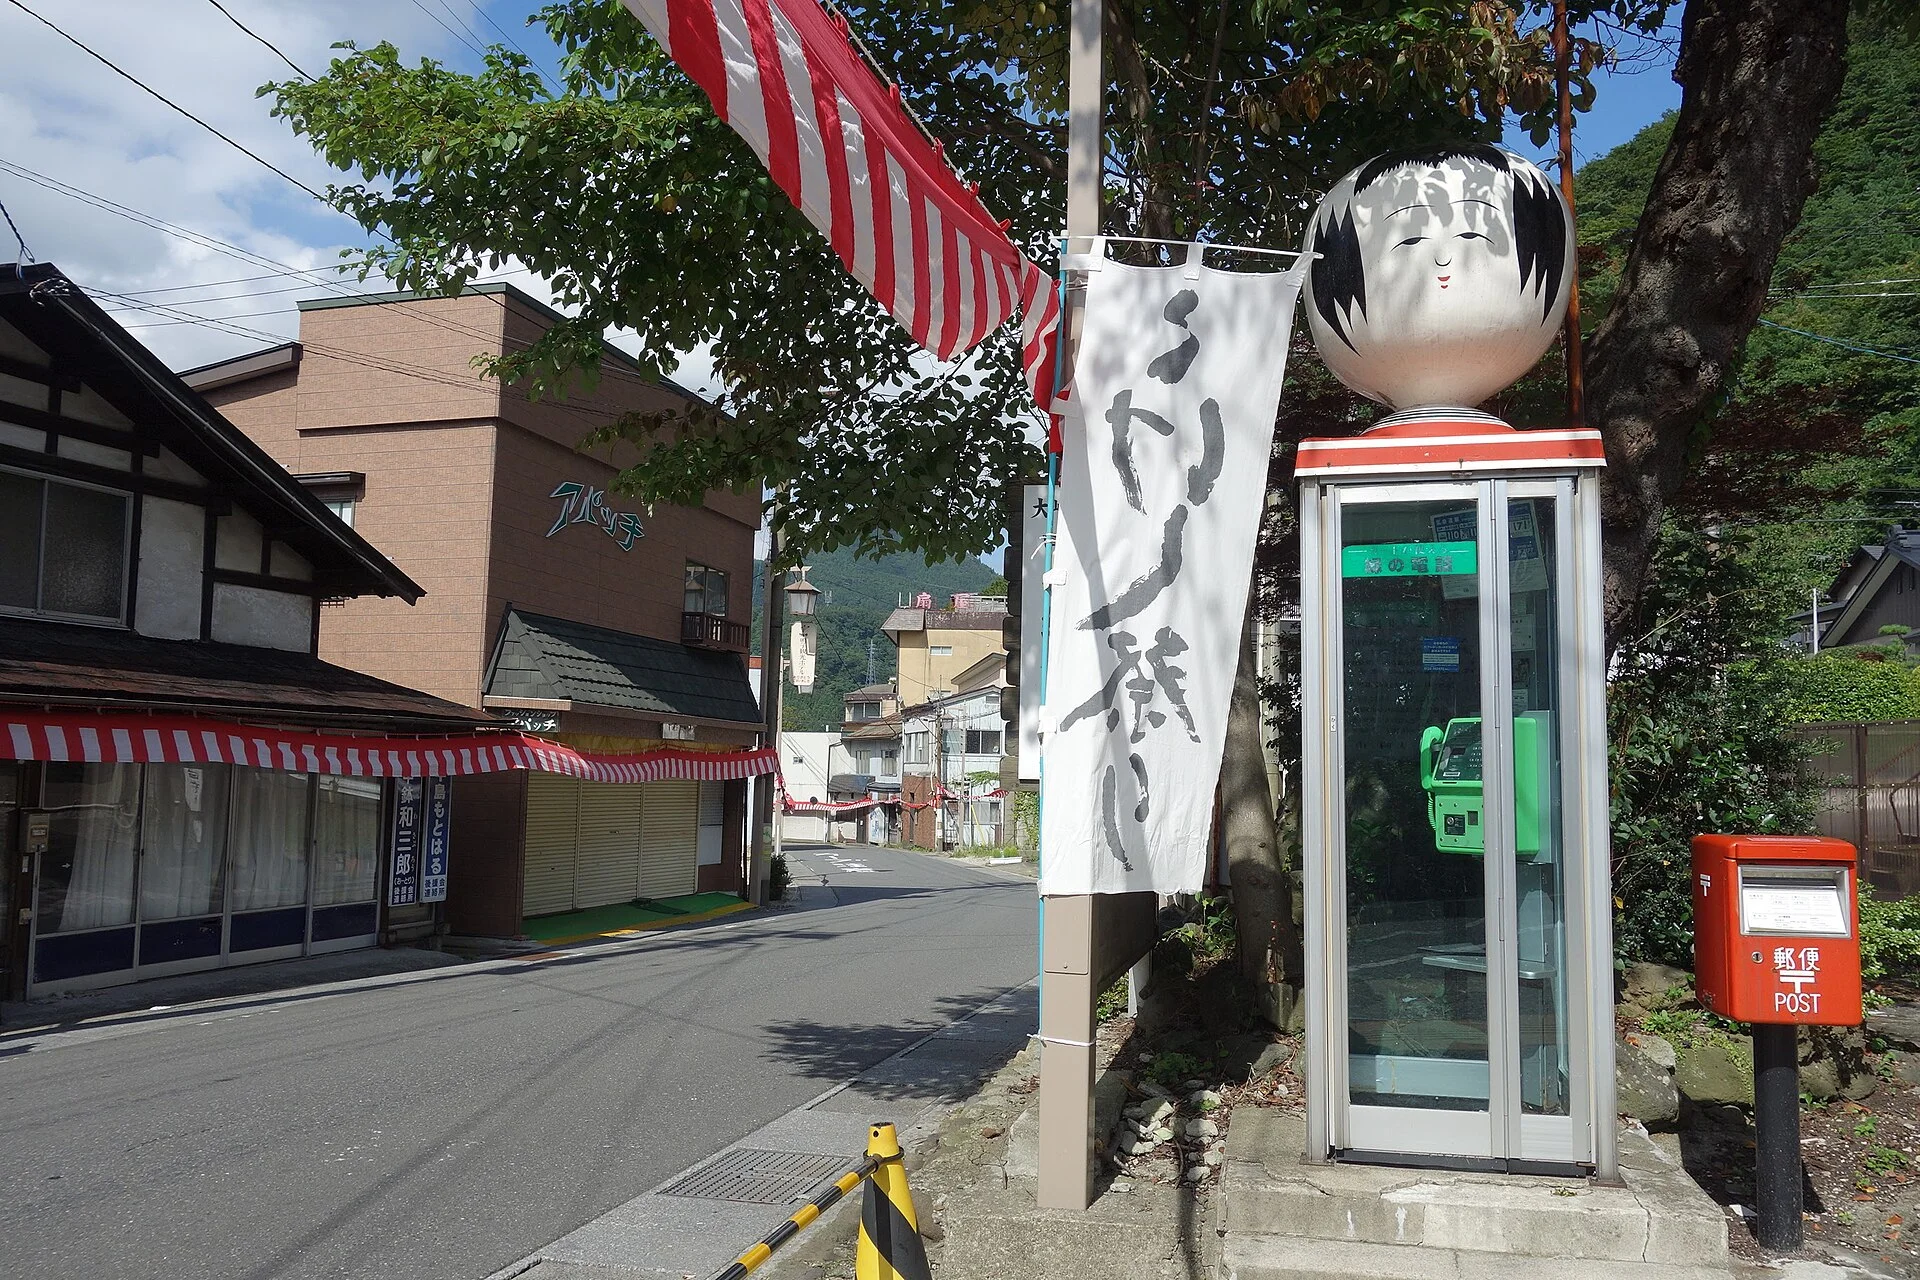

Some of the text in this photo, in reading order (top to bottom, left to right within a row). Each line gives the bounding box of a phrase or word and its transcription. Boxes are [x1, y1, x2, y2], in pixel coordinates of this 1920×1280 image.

[545, 481, 646, 551] アパッチ
[430, 777, 446, 874] 島もとはる
[425, 878, 446, 888] 後援会
[1773, 946, 1821, 971] 郵便
[1774, 993, 1822, 1014] POST
